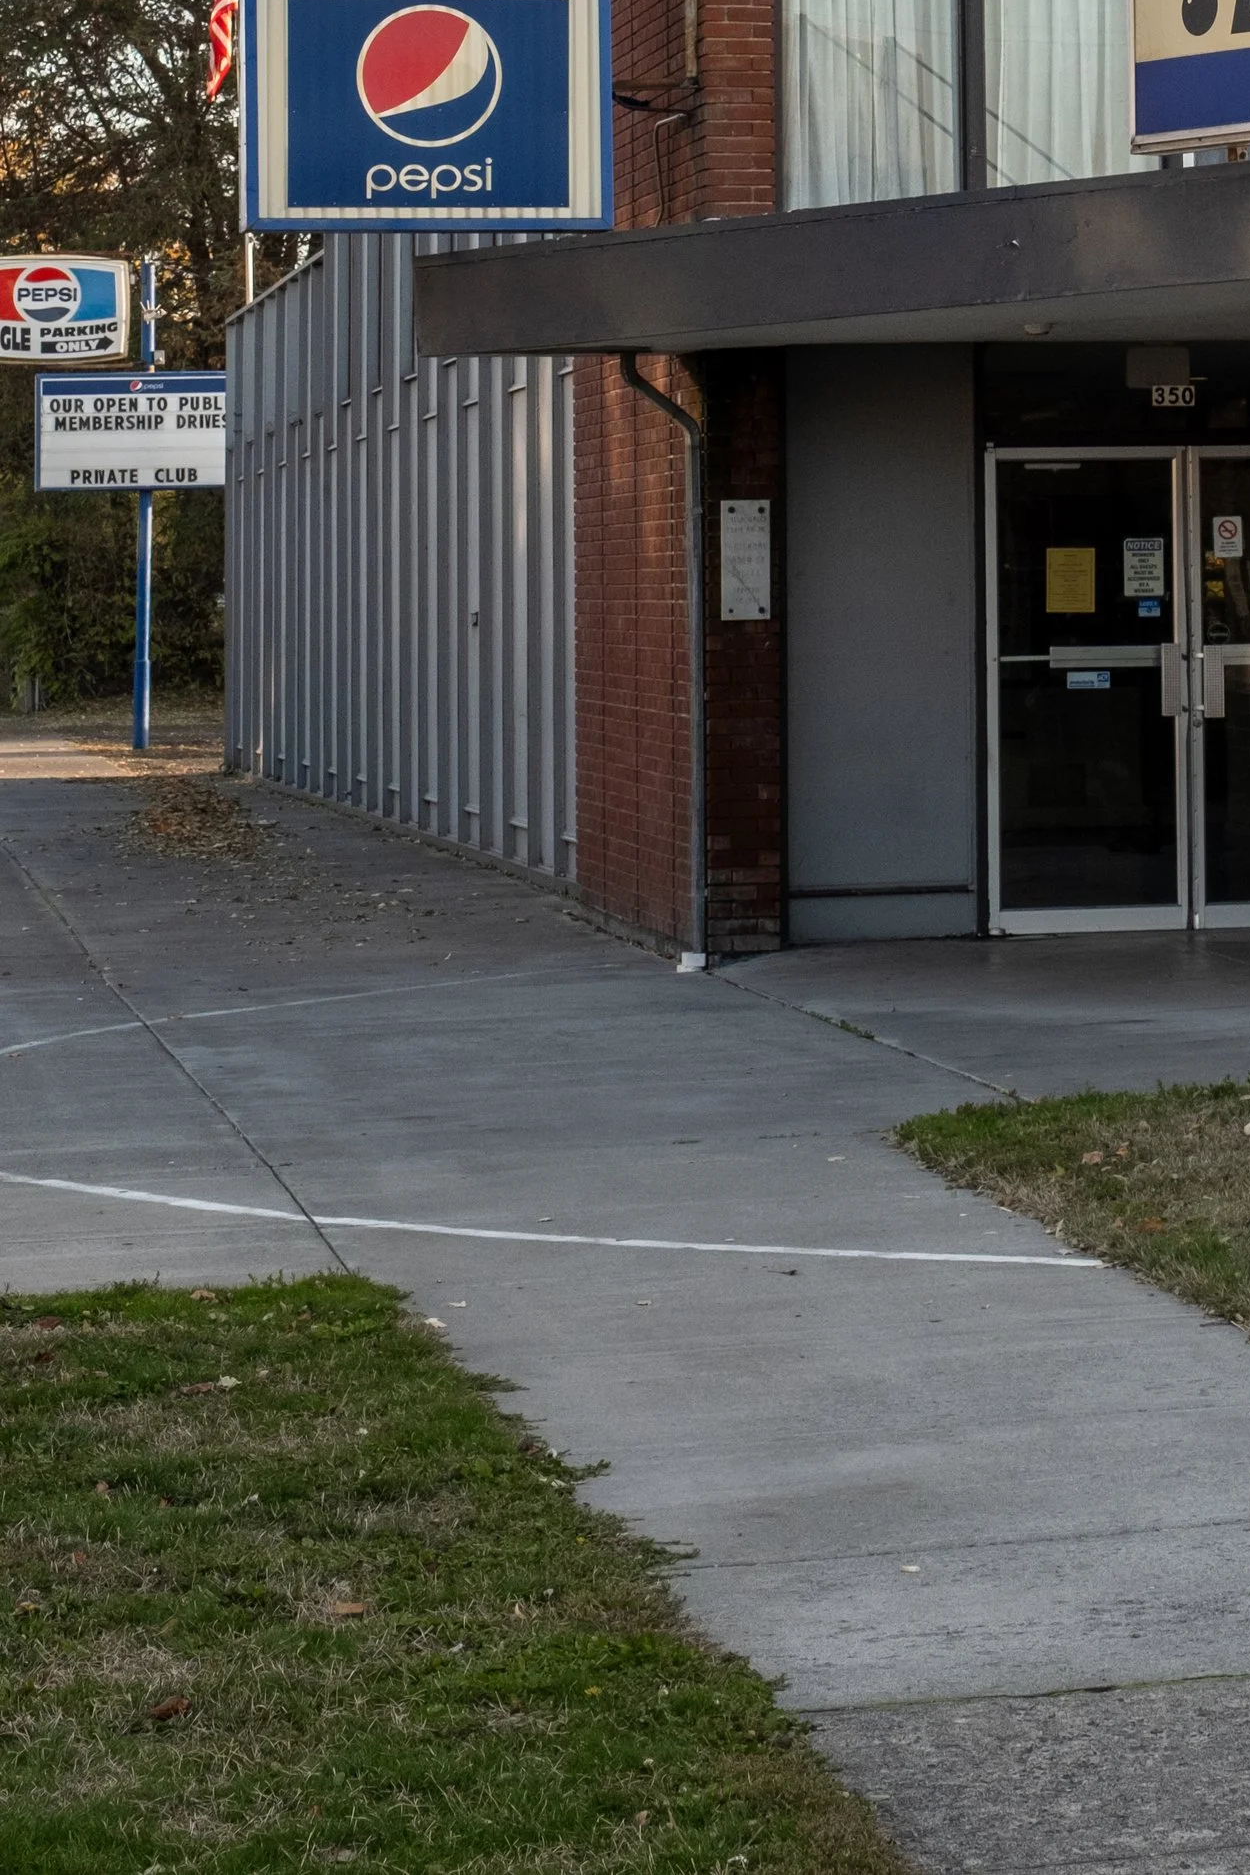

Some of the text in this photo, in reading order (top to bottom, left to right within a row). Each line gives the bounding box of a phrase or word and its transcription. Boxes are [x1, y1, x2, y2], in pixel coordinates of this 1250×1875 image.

[365, 156, 493, 200] pepsi
[17, 286, 78, 302] PEPSI
[0, 322, 118, 352] GLE PARKING
[55, 338, 100, 353] ONLY
[143, 381, 164, 391] pepsi
[1154, 386, 1195, 405] 350
[50, 398, 84, 413] OUR
[93, 397, 139, 413] OPEN
[146, 397, 168, 412] TO
[54, 415, 164, 431] MEMBERSHIP
[71, 467, 198, 484] PRIVATE CLUB
[1126, 541, 1161, 550] NOTICE
